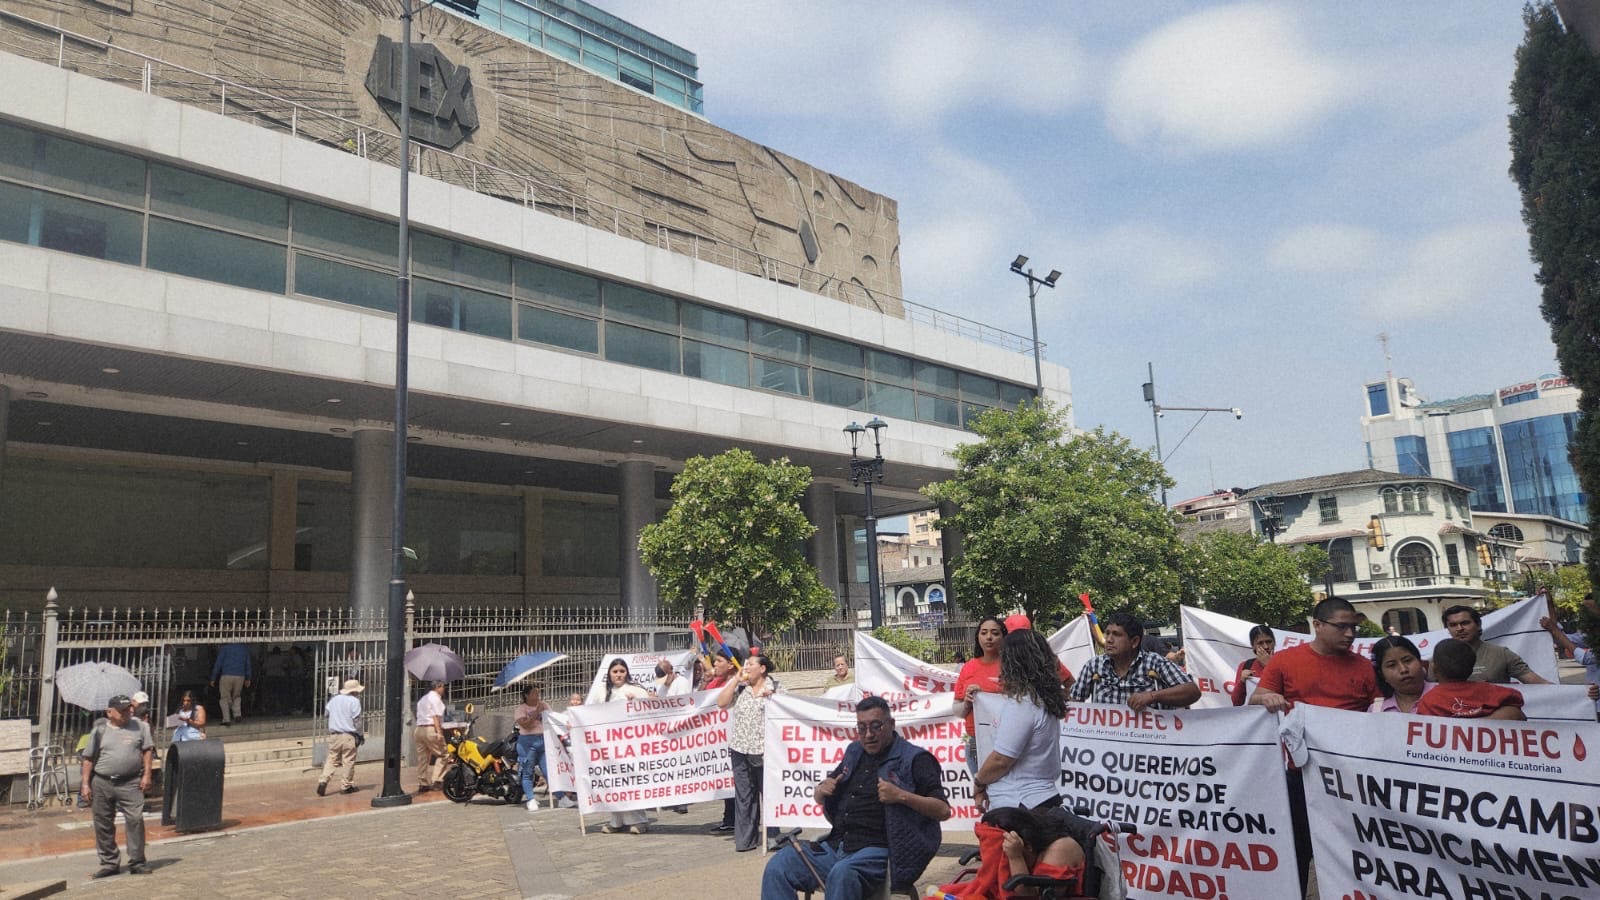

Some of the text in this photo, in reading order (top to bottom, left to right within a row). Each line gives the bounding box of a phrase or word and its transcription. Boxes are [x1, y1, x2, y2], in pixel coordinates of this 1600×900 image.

[1198, 677, 1220, 693] EL
[626, 698, 686, 713] FUNDHEC
[584, 709, 729, 744] EL INCUMPLIMIENTO
[1063, 707, 1168, 731] FUNDHEC
[590, 727, 728, 761] DE LA RESOLUCIÓN
[782, 726, 806, 742] EL
[1406, 721, 1561, 760] FUNDHEC
[588, 765, 617, 776] PONE
[620, 762, 635, 773] EN
[638, 757, 678, 771] RIESGO
[680, 755, 692, 765] LA
[694, 750, 718, 763] VIDA
[787, 747, 845, 763] DE LA
[1061, 746, 1217, 777] NO QUEREMOS
[1406, 750, 1456, 763] Fundación
[1508, 760, 1563, 774] Ecuatoriana
[591, 775, 650, 789] PACIENTES
[652, 771, 674, 783] CON
[782, 770, 821, 782] PONE
[942, 769, 971, 783] IDA
[1061, 770, 1228, 805] PRODUCTOS DE
[605, 791, 641, 803] CORTE
[644, 786, 671, 799] DEBE
[1319, 766, 1600, 843] EL INTERCAMB
[775, 803, 798, 817] ¡LA
[1061, 794, 1276, 836] ORIGEN DE RATÓN.
[1126, 832, 1279, 872] CALIDAD
[1351, 813, 1600, 890] MEDICAMEN
[1122, 859, 1229, 900] RIDAD!
[1352, 850, 1451, 900] PARA
